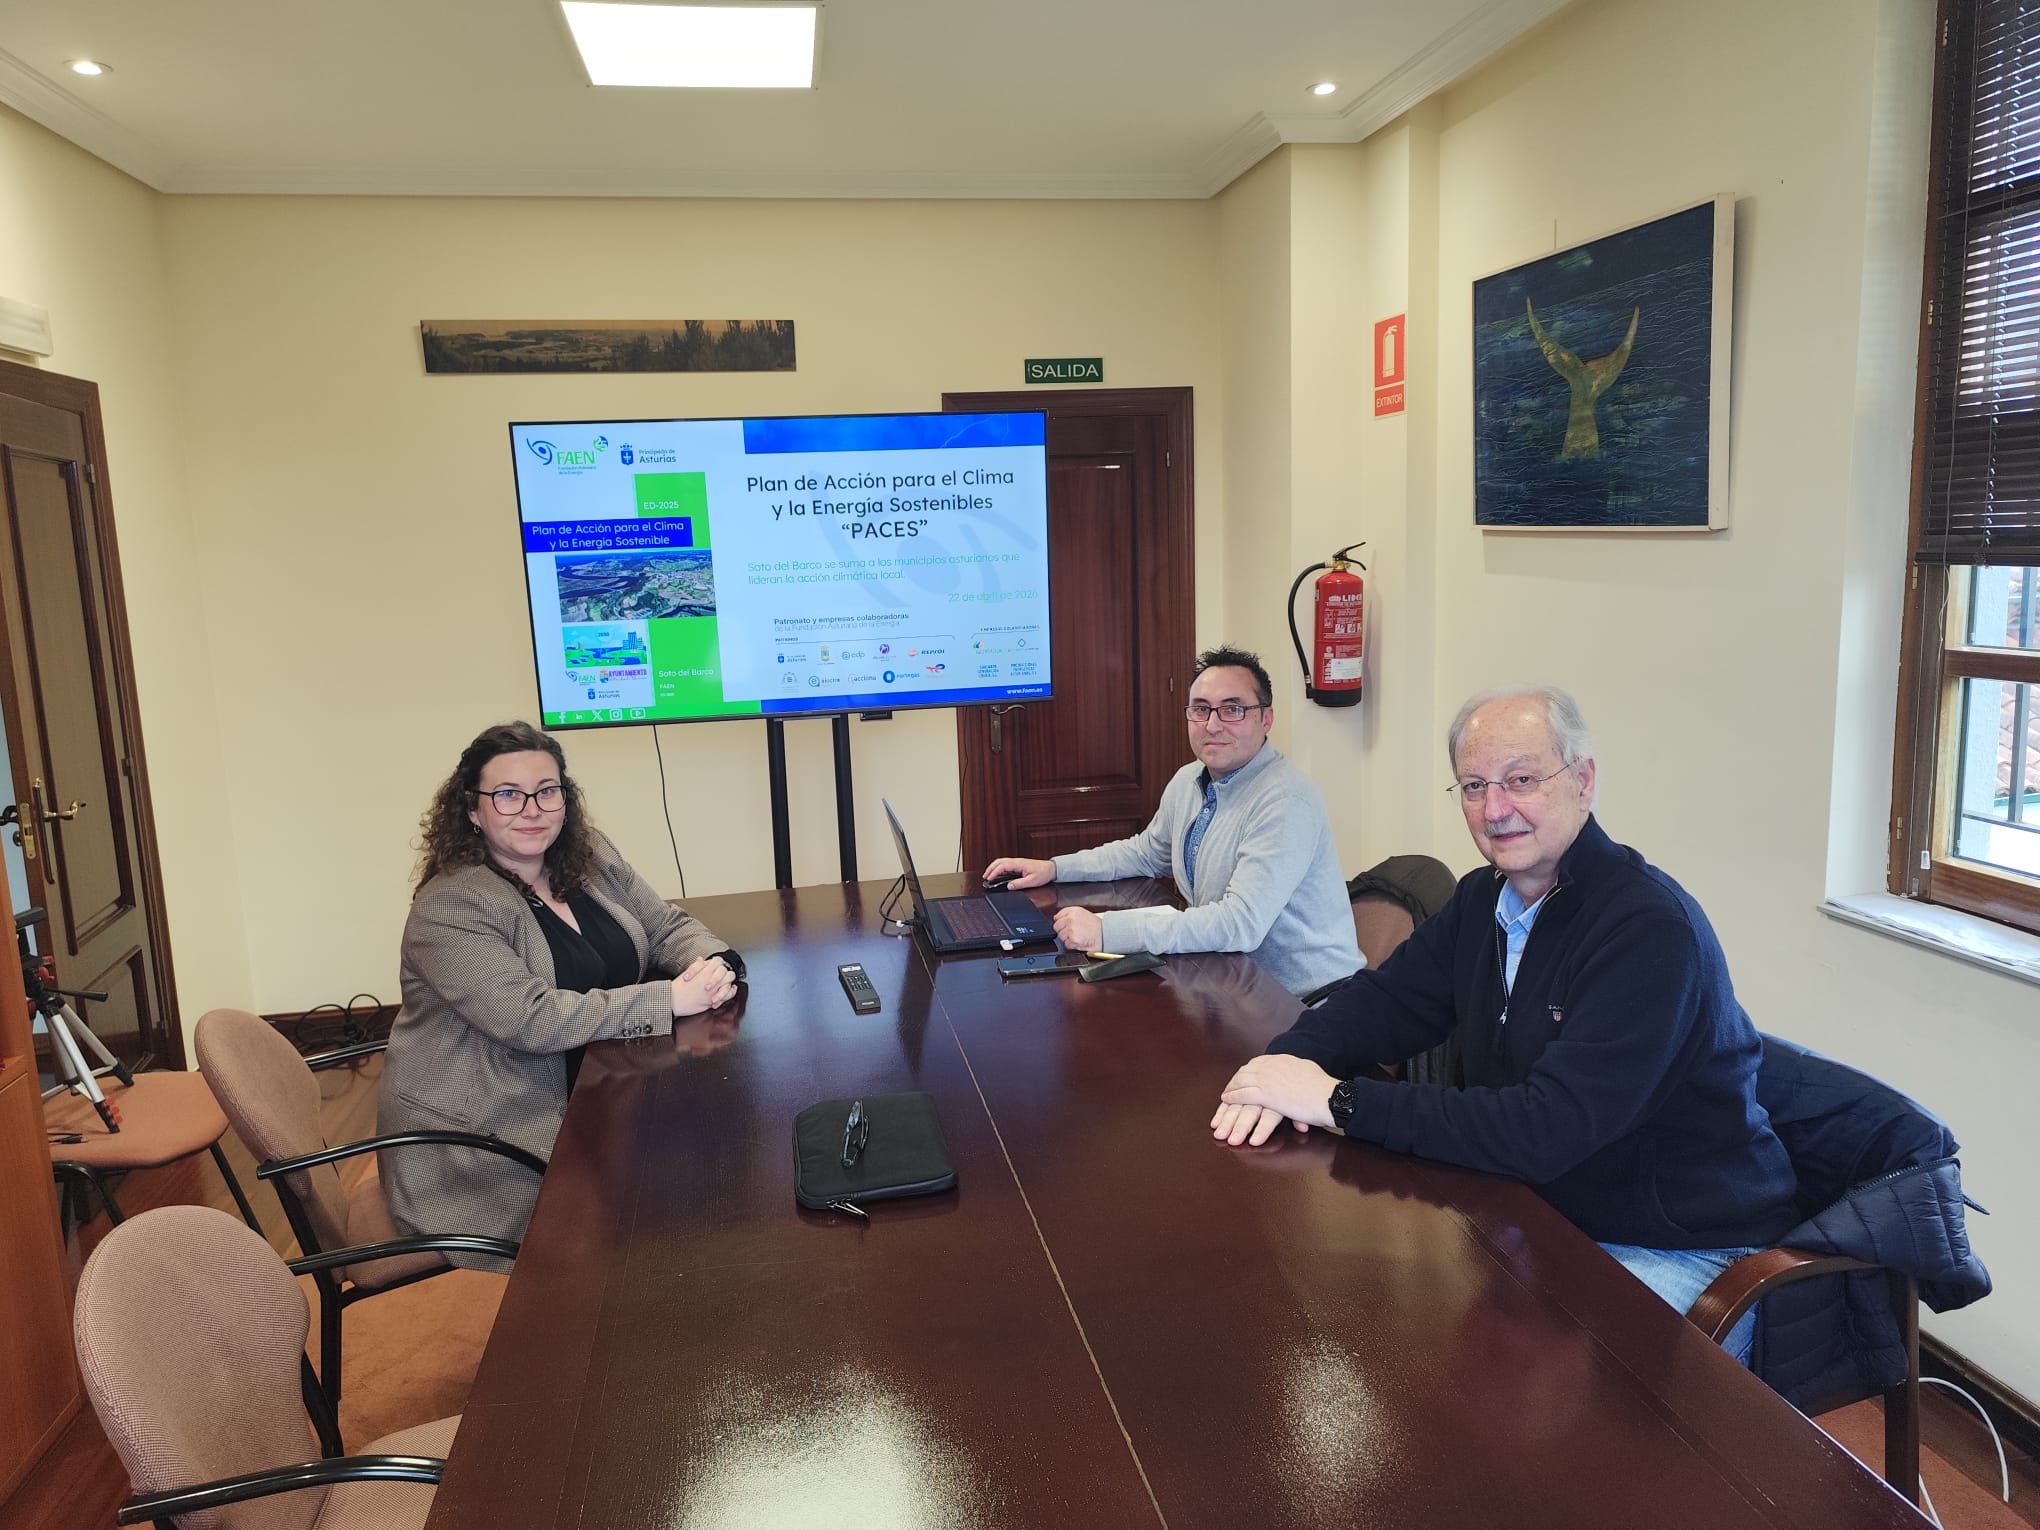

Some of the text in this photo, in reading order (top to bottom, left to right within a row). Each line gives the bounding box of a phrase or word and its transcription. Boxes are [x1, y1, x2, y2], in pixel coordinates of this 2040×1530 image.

[1031, 363, 1099, 378] SALIDA
[1376, 392, 1403, 408] EXTINTOR
[556, 450, 596, 465] FAEN
[639, 454, 677, 464] Asturias
[747, 468, 1015, 493] Plan de Acción para el Clima
[643, 500, 680, 510] ED-2025
[771, 494, 993, 521] y la Energía Sostenibles
[531, 520, 685, 536] Plan de Acción para el Clima
[549, 540, 557, 551] y
[558, 538, 569, 549] la
[615, 535, 671, 547] Sostenible
[747, 552, 1020, 572] Soto del Barco se suma a los municipios asturianos que
[748, 574, 783, 585] lideran
[785, 574, 795, 584] la
[797, 572, 831, 583] acción
[832, 571, 878, 582] climática
[774, 617, 811, 625] Patronato
[818, 616, 855, 625] empresas
[856, 613, 909, 622] colaboradoras
[608, 668, 648, 678] AYUNTAMIENTO
[658, 669, 677, 678] Soto
[677, 668, 690, 677] del
